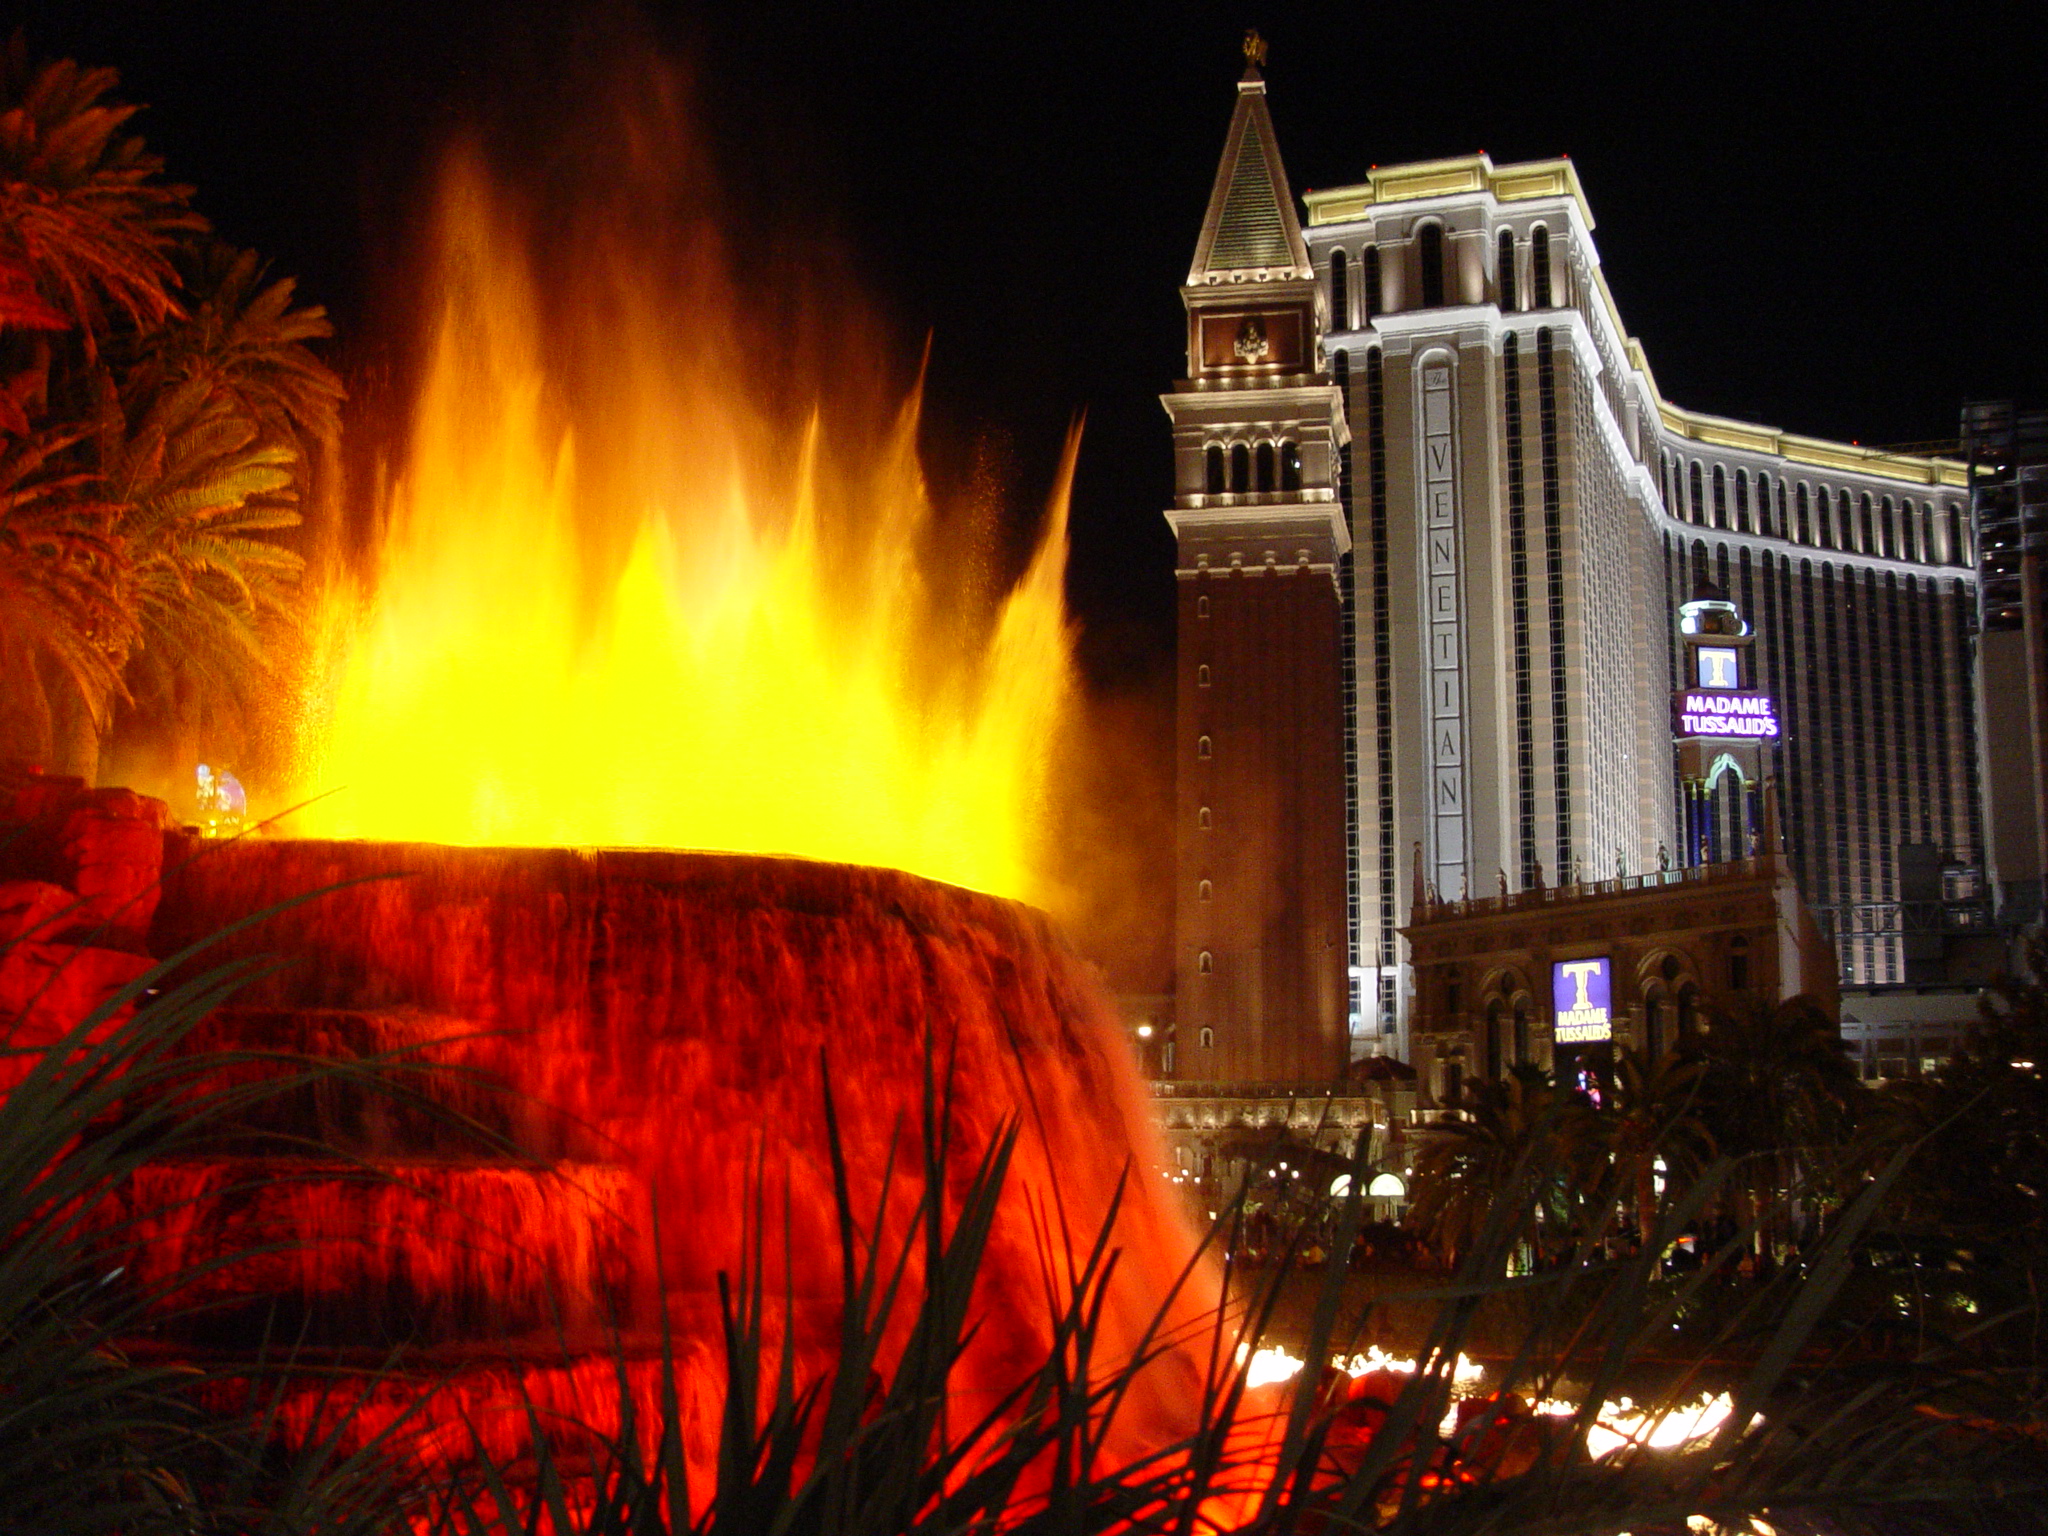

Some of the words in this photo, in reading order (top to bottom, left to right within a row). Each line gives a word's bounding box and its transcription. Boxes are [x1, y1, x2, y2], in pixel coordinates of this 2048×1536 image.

[1431, 443, 1457, 805] VENETIAN
[1699, 651, 1737, 687] T
[1686, 695, 1771, 715] MADAME
[1681, 715, 1777, 736] TUSSAUD'S
[1562, 962, 1601, 1010] T
[1557, 1008, 1607, 1027] MADAME
